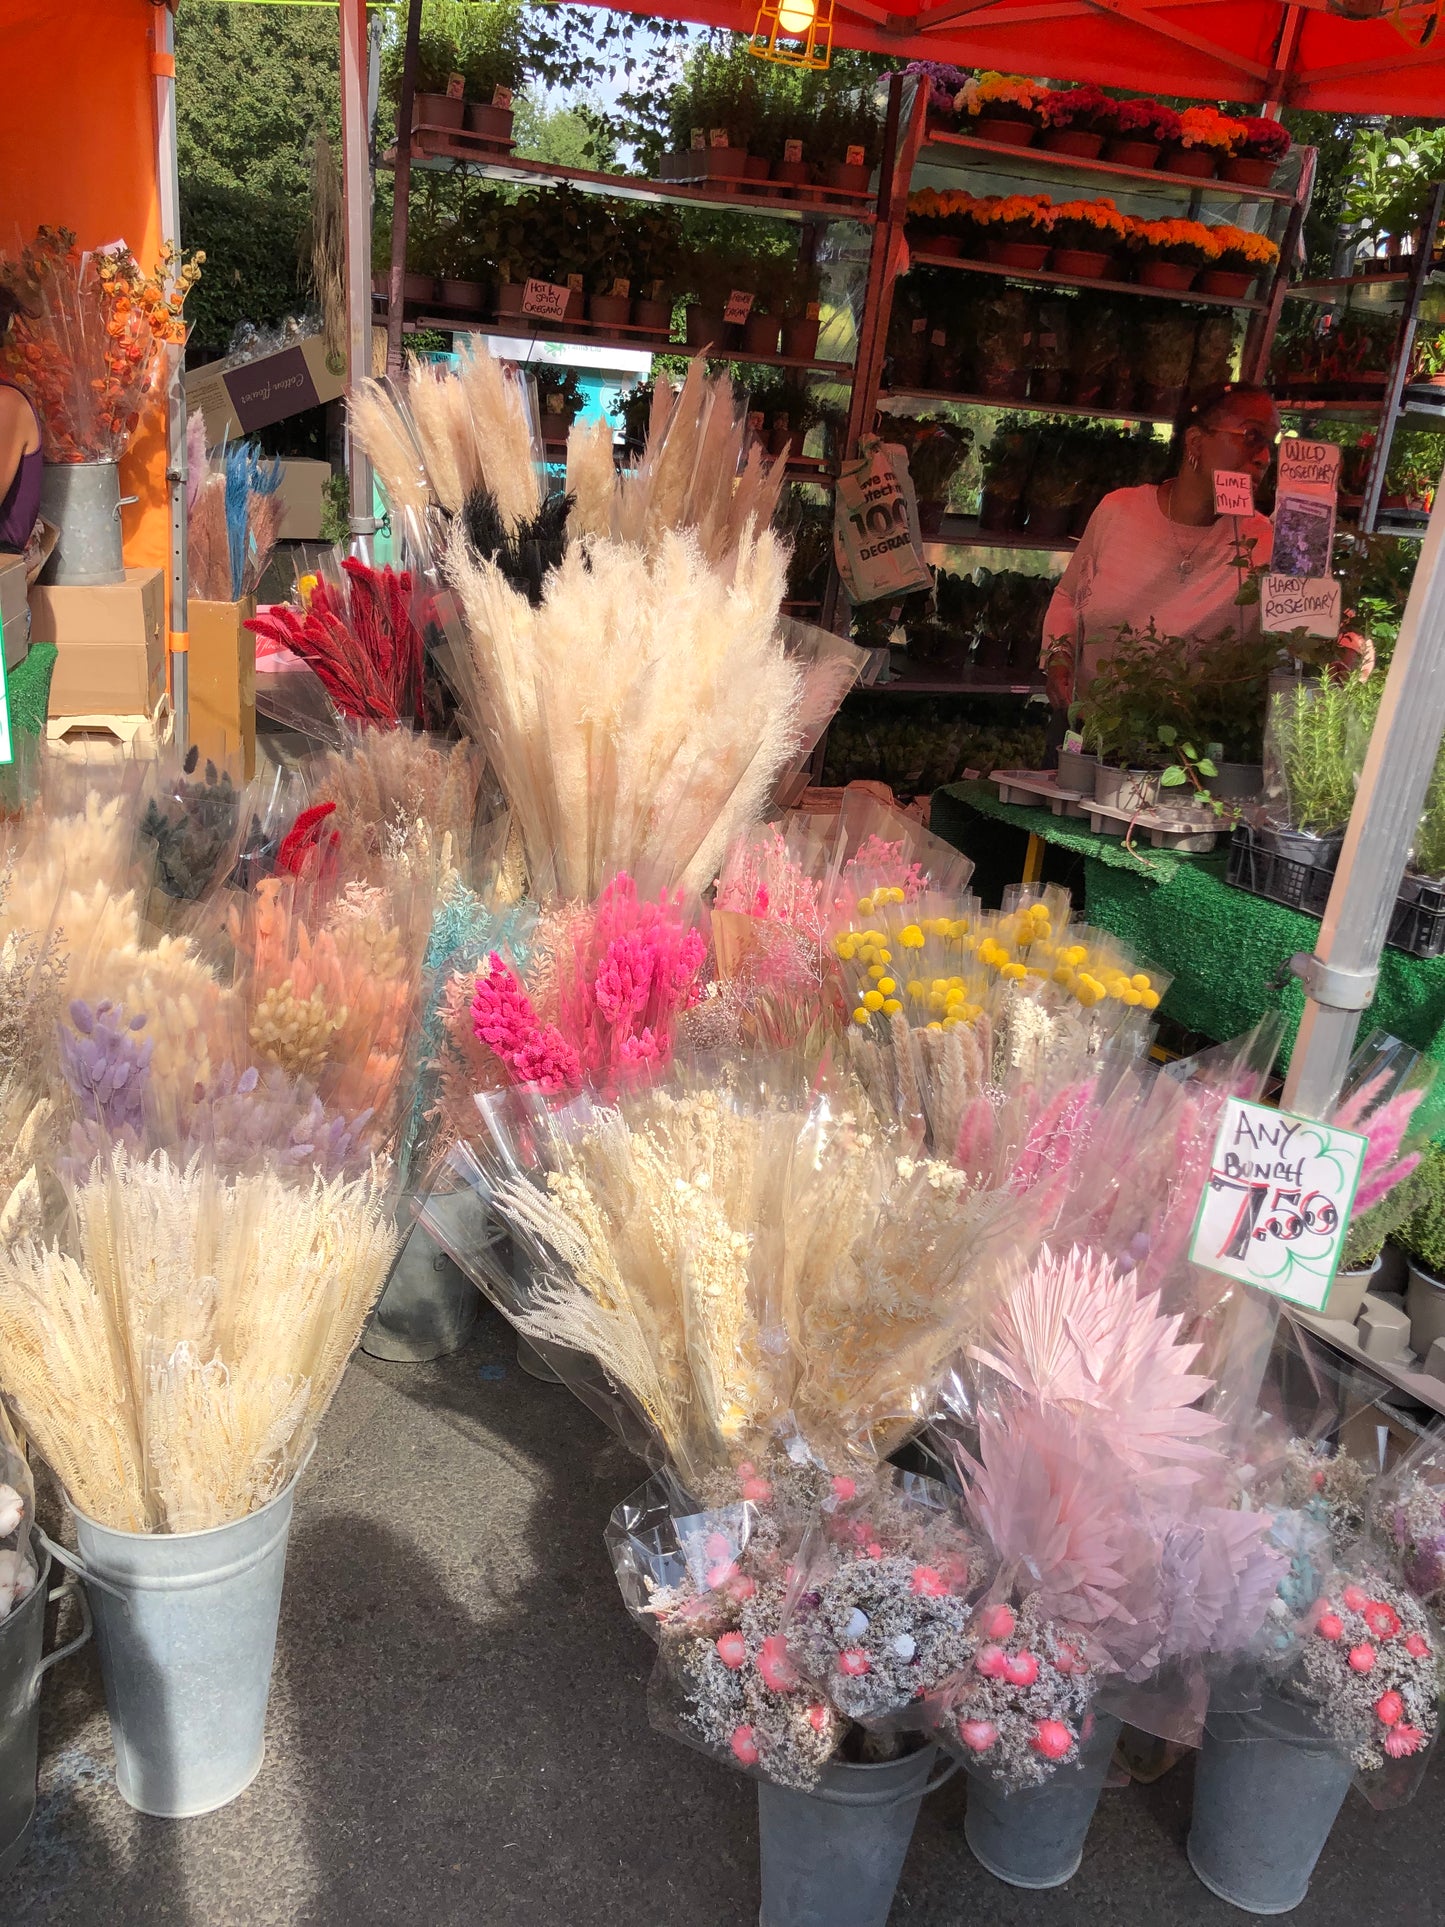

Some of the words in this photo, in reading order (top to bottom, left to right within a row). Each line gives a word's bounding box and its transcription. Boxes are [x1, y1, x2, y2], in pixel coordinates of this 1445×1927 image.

[530, 282, 546, 293] HOT
[524, 302, 563, 316] OREGANO
[535, 293, 561, 307] SPICY
[273, 372, 304, 390] Cotton
[1285, 441, 1326, 461] WILD
[1216, 473, 1251, 489] LIME
[1280, 462, 1339, 489] ROSEMARY
[1216, 493, 1249, 509] MINT
[1264, 589, 1339, 618] ROSEMARY
[1233, 1110, 1302, 1160] ANY
[1210, 1168, 1339, 1261] 7.50
